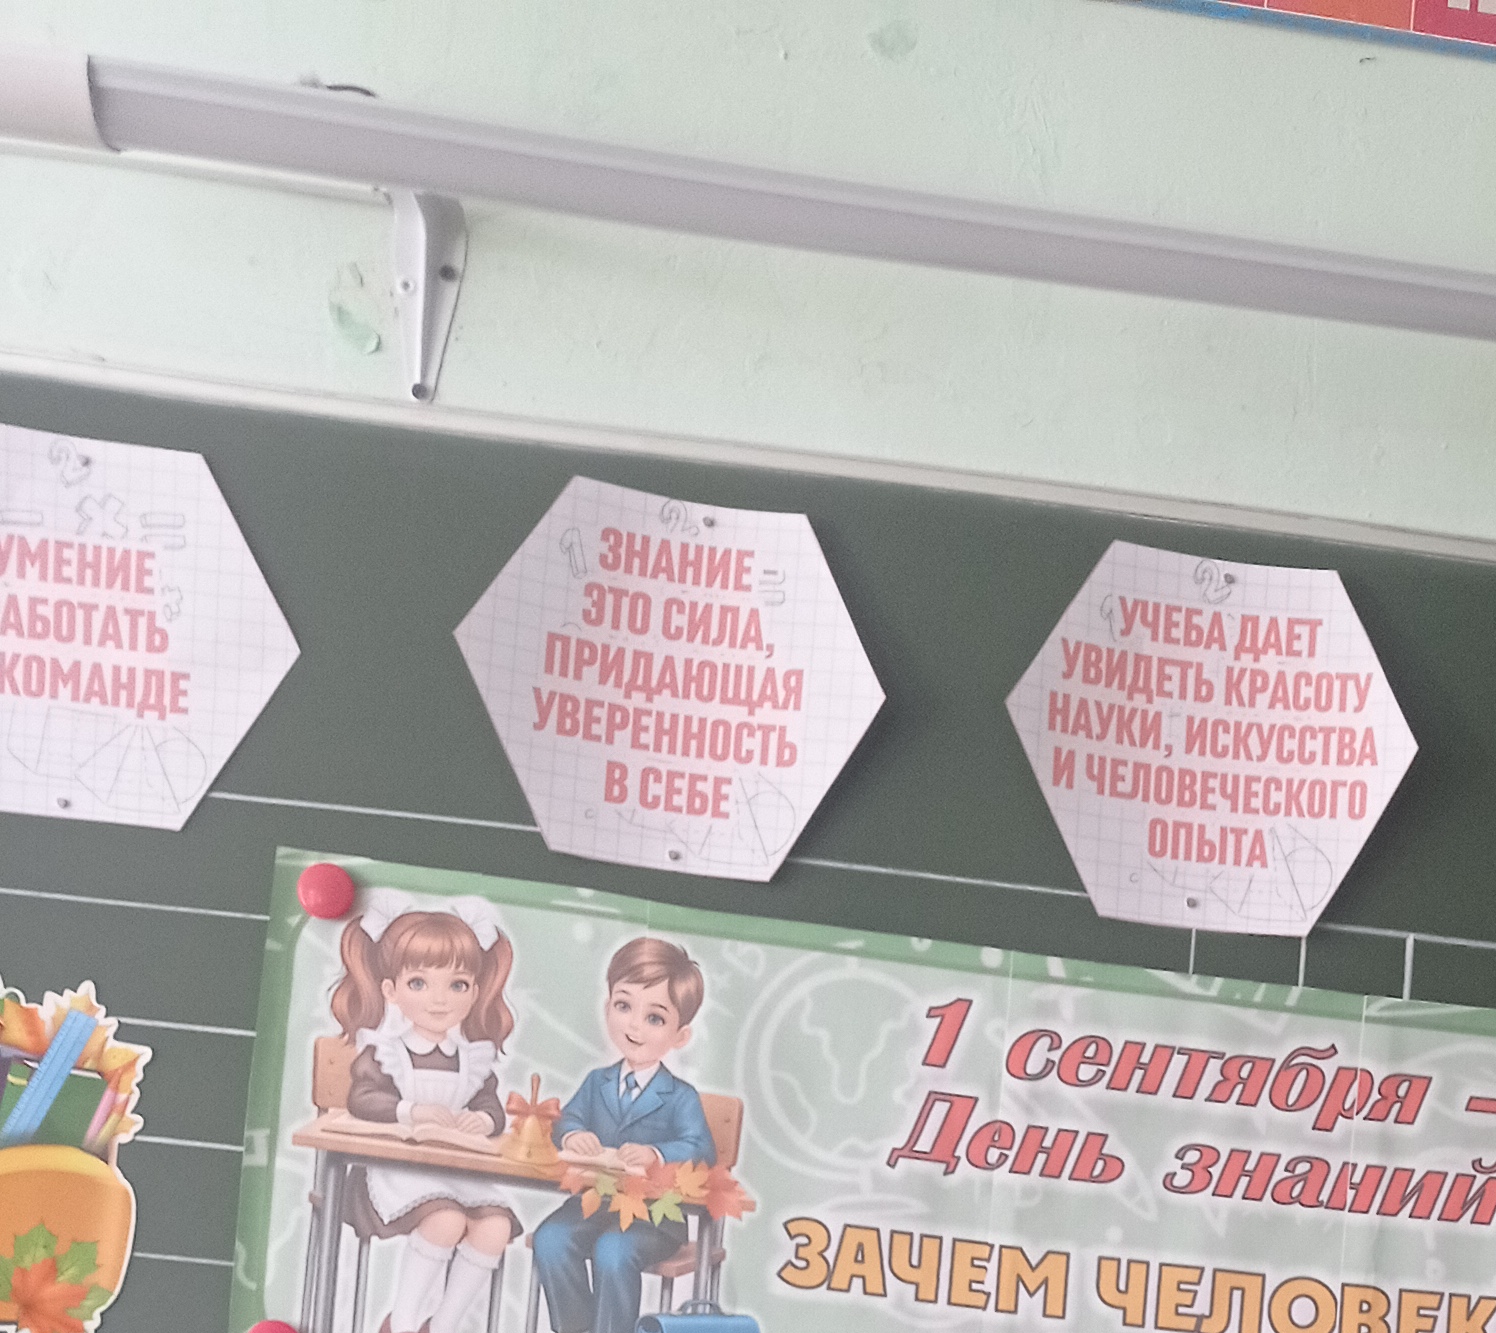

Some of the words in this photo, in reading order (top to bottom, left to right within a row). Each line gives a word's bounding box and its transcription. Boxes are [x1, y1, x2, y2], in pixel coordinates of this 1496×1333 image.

[599, 527, 756, 592] ЗНАНИЕ
[0, 594, 170, 654] АБОТАТЬ
[581, 582, 652, 635] ЭТО
[661, 597, 776, 658] СИЛА,
[1118, 596, 1227, 652] УЧЕБА
[1234, 613, 1324, 663] ДАЕТ
[0, 650, 191, 721] КОМАНДЕ
[543, 631, 804, 717] ПРИДАЮЩАЯ
[1060, 637, 1215, 704] УВИДЕТЬ
[1224, 665, 1374, 713] КРАСОТУ
[531, 686, 798, 768] УВЕРЕННОСТЬ
[1047, 690, 1174, 758] НАУКИ,
[1184, 714, 1379, 767] ИСКУССТВА
[603, 760, 629, 804] В
[639, 766, 733, 819] СЕБЕ
[1051, 746, 1076, 790] И
[1085, 753, 1368, 821] ЧЕЛОВЕЧЕСКОГО
[1147, 817, 1268, 868] ОПЫТА
[920, 998, 973, 1068] 1
[1005, 1027, 1433, 1132] сентября
[886, 1090, 1126, 1185] День
[776, 1215, 1071, 1319] ЗАЧЕМ
